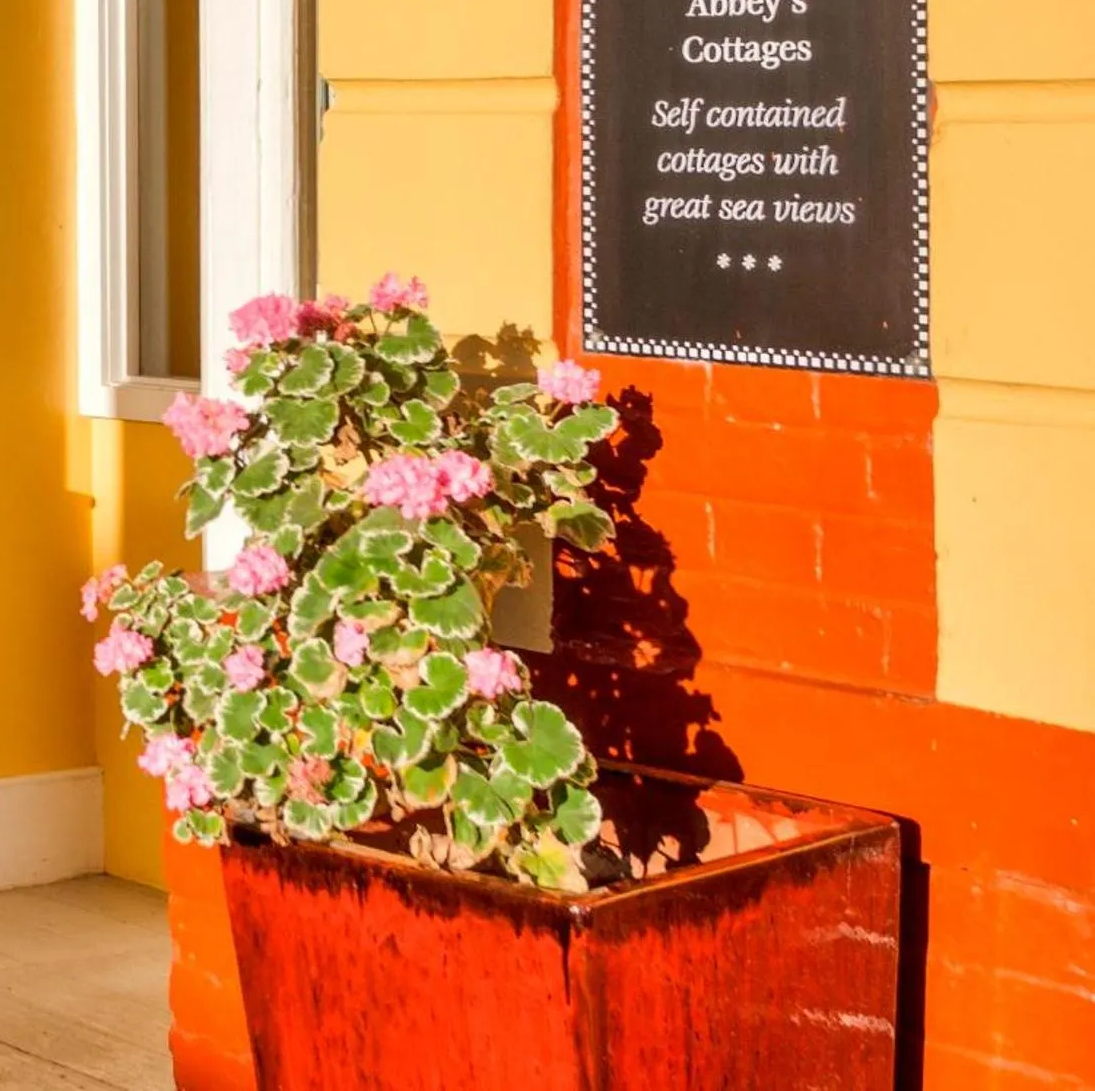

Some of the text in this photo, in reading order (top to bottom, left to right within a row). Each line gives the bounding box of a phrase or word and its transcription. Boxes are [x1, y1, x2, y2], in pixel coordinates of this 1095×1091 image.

[682, 36, 812, 69] Cottages
[651, 97, 848, 135] Self contained
[657, 145, 840, 181] cottages with
[642, 194, 857, 225] great sea views
